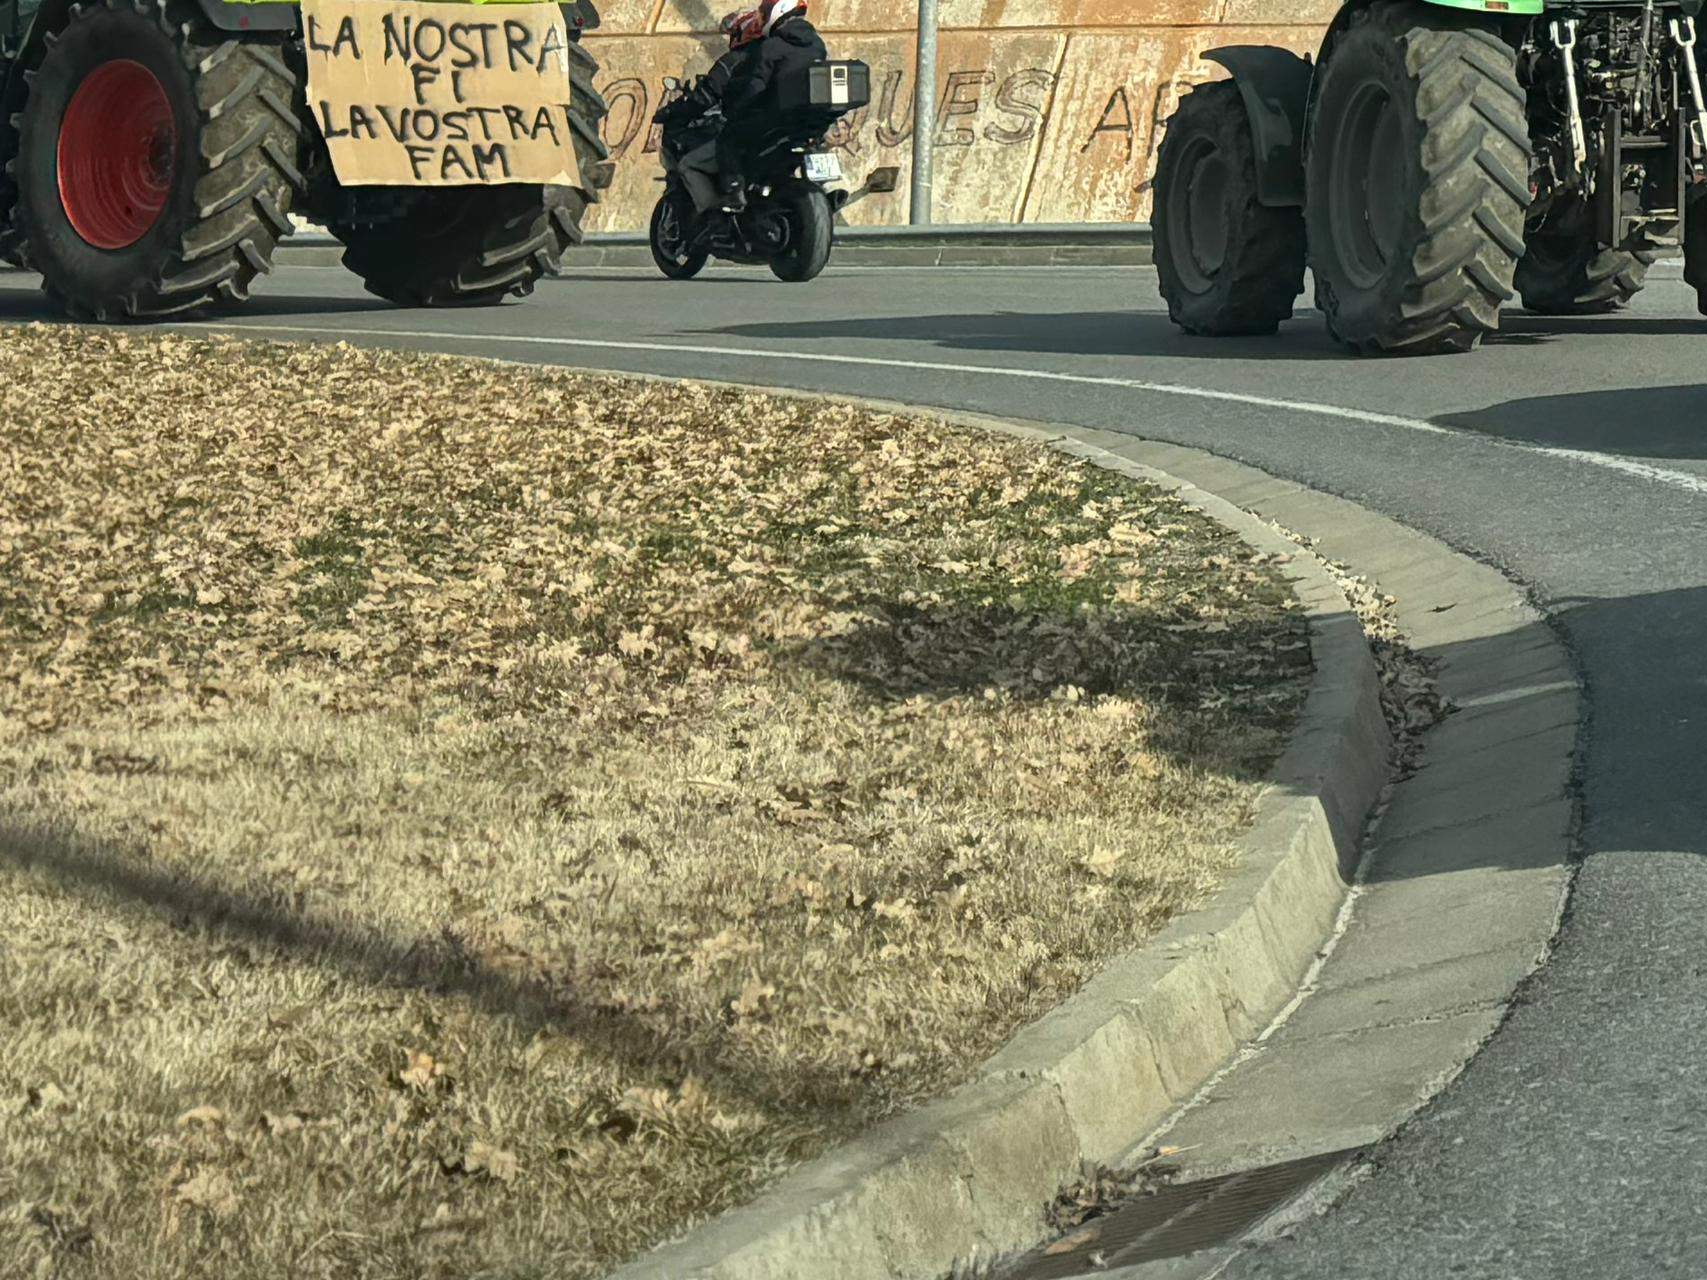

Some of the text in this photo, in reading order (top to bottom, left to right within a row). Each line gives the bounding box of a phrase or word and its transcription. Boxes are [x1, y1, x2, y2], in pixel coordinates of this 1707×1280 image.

[307, 13, 567, 73] LA NOSTRA
[410, 63, 466, 105] FI
[405, 143, 511, 180] FAM
